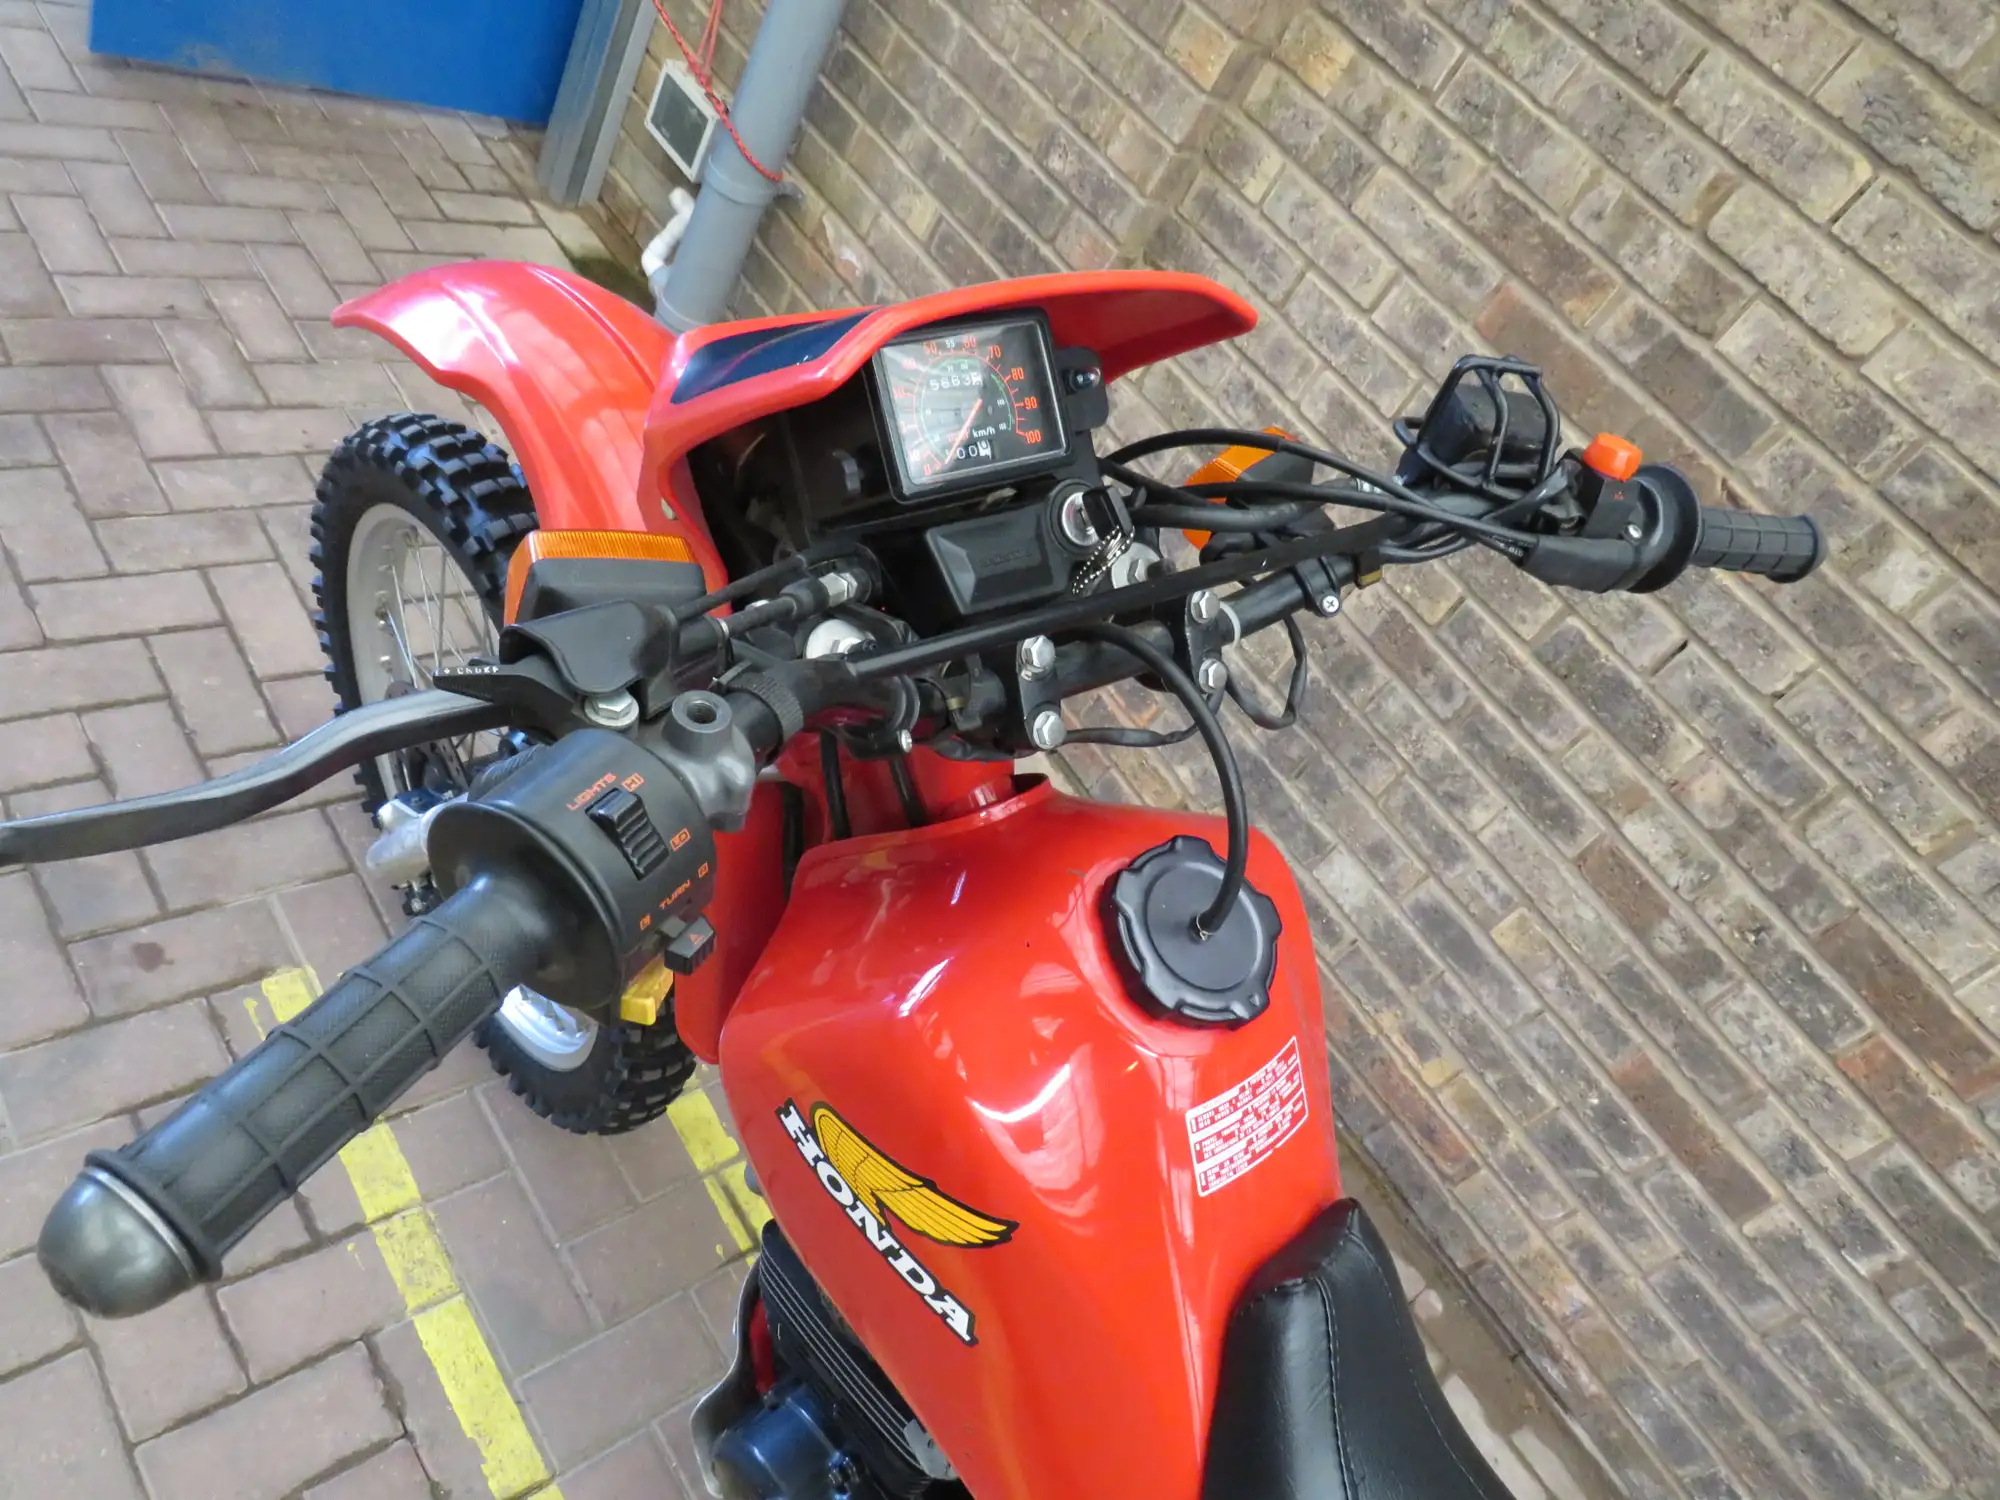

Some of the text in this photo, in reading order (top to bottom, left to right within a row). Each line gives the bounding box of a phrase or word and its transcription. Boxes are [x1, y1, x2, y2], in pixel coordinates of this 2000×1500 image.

[988, 345, 1002, 358] 70
[1011, 367, 1025, 381] 80
[1024, 395, 1038, 410] 90
[972, 426, 996, 438] km/h
[1025, 430, 1042, 444] 100
[566, 772, 616, 811] LIGHTS
[659, 879, 691, 909] TURN
[780, 1105, 971, 1341] HONDA
